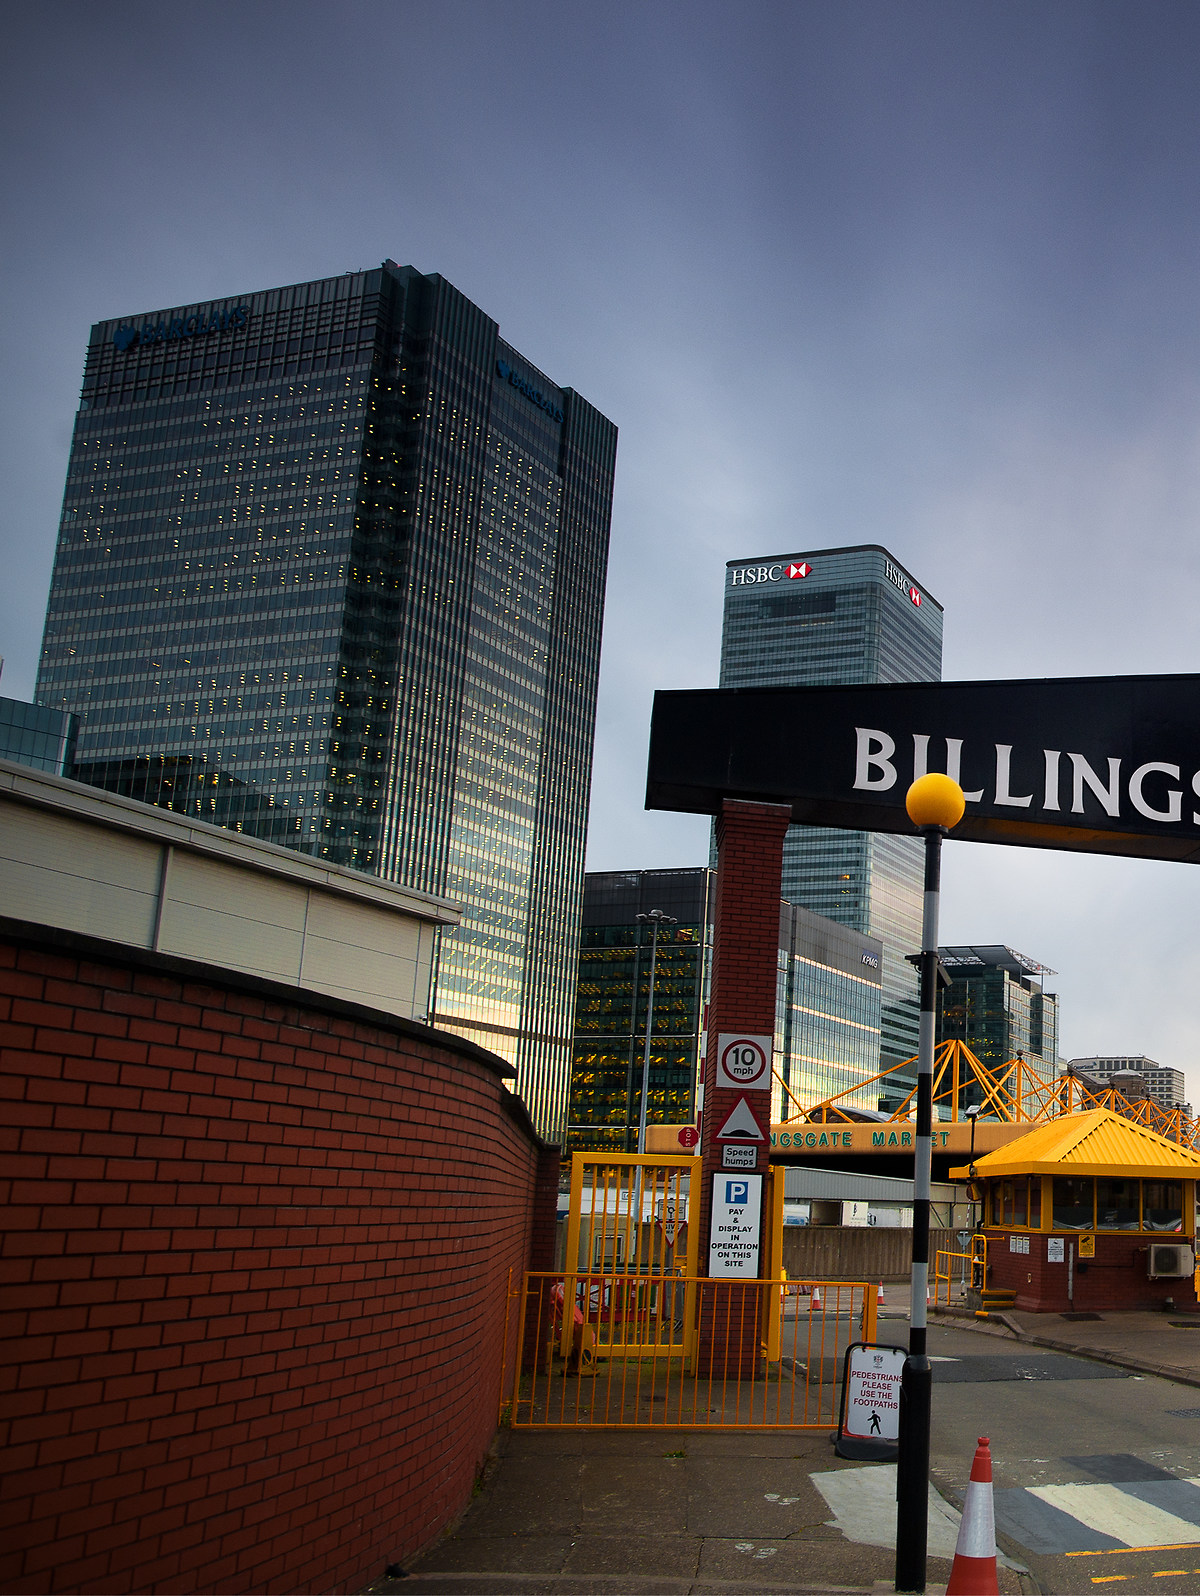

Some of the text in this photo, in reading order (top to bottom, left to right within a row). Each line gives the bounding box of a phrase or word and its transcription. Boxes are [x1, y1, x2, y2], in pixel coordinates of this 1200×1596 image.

[139, 305, 248, 345] BARCLAYS
[511, 370, 564, 424] BARCLAYS
[731, 564, 783, 586] HSBC
[884, 560, 910, 596] HSBC
[862, 954, 879, 969] KPMG
[732, 1047, 756, 1066] 10
[733, 1066, 754, 1076] mph
[872, 1131, 950, 1146] MARET
[726, 1148, 754, 1158] Speed
[725, 1157, 754, 1167] humps
[730, 1183, 746, 1202] P
[711, 1242, 758, 1250] OPERATION
[851, 1370, 902, 1382] PEDESTRIANS
[862, 1381, 892, 1390] PLEASE
[860, 1390, 893, 1399] USE THE
[853, 1398, 898, 1409] FOOTPATHS
